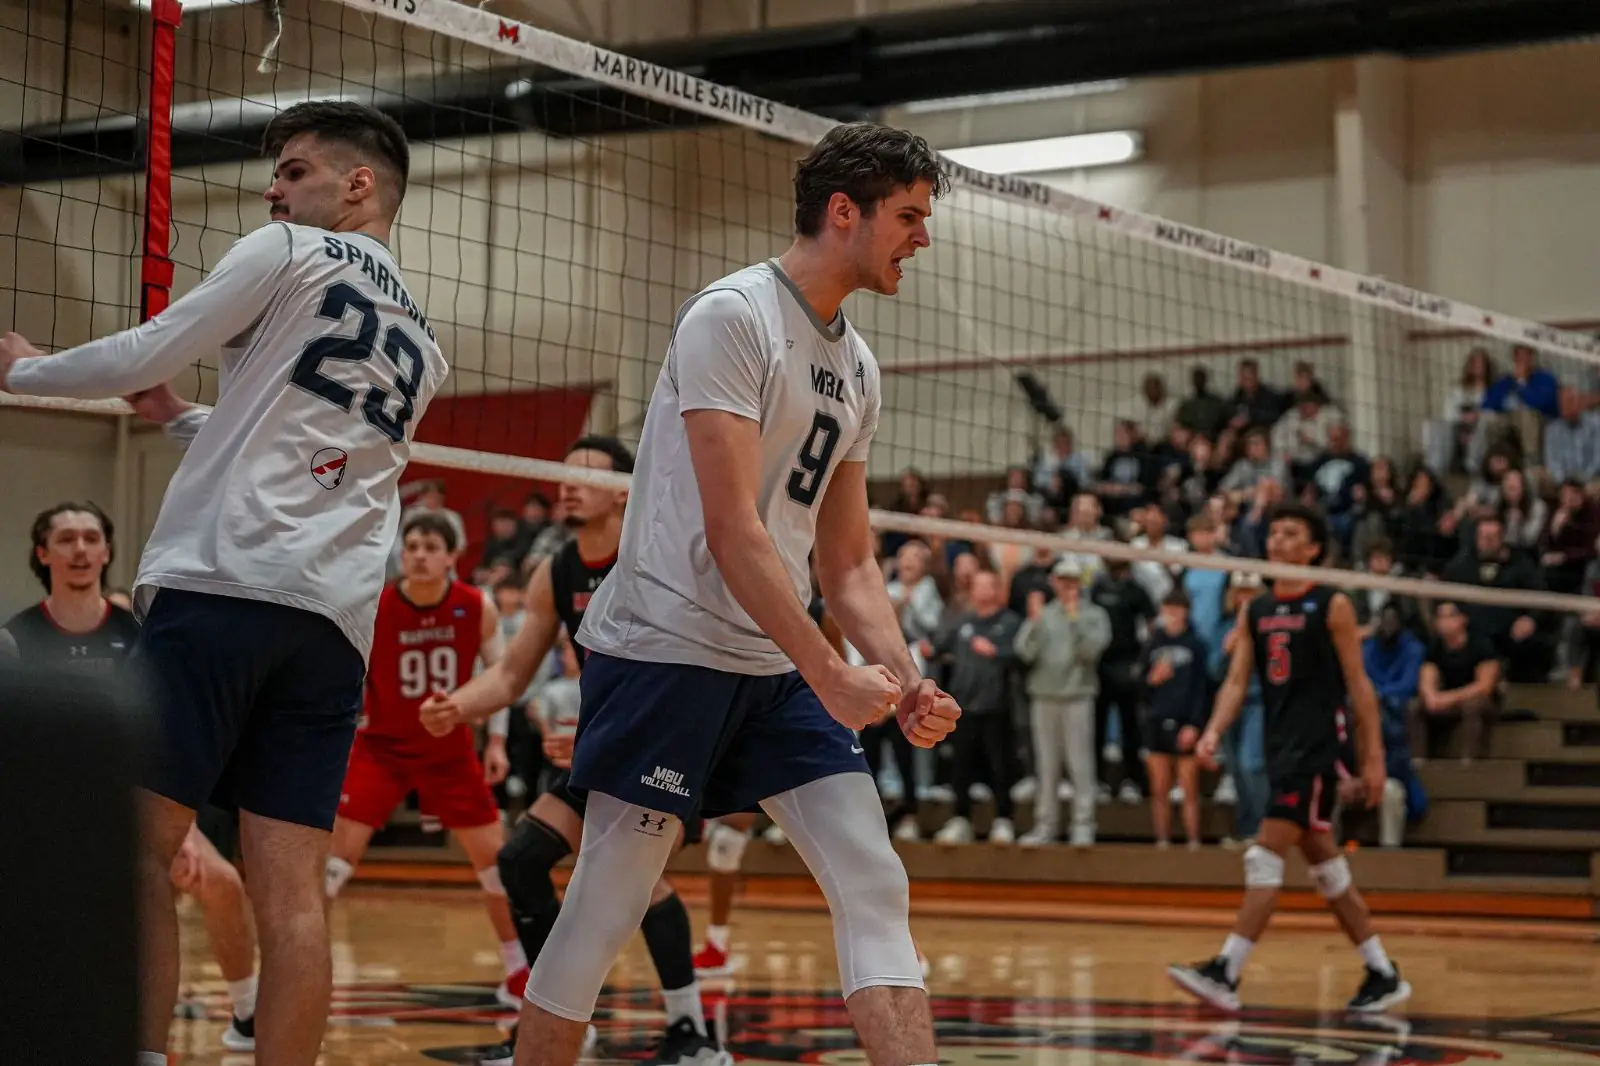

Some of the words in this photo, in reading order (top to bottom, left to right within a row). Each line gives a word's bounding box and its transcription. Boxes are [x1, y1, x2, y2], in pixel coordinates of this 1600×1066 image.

[594, 50, 704, 102] MARYVILLE
[709, 84, 775, 124] SAINTS
[287, 279, 425, 444] 23
[785, 409, 843, 508] 9
[398, 645, 458, 699] 99
[1267, 631, 1292, 686] 5
[640, 774, 690, 797] VOLLEYBALL
[652, 765, 685, 786] MBU
